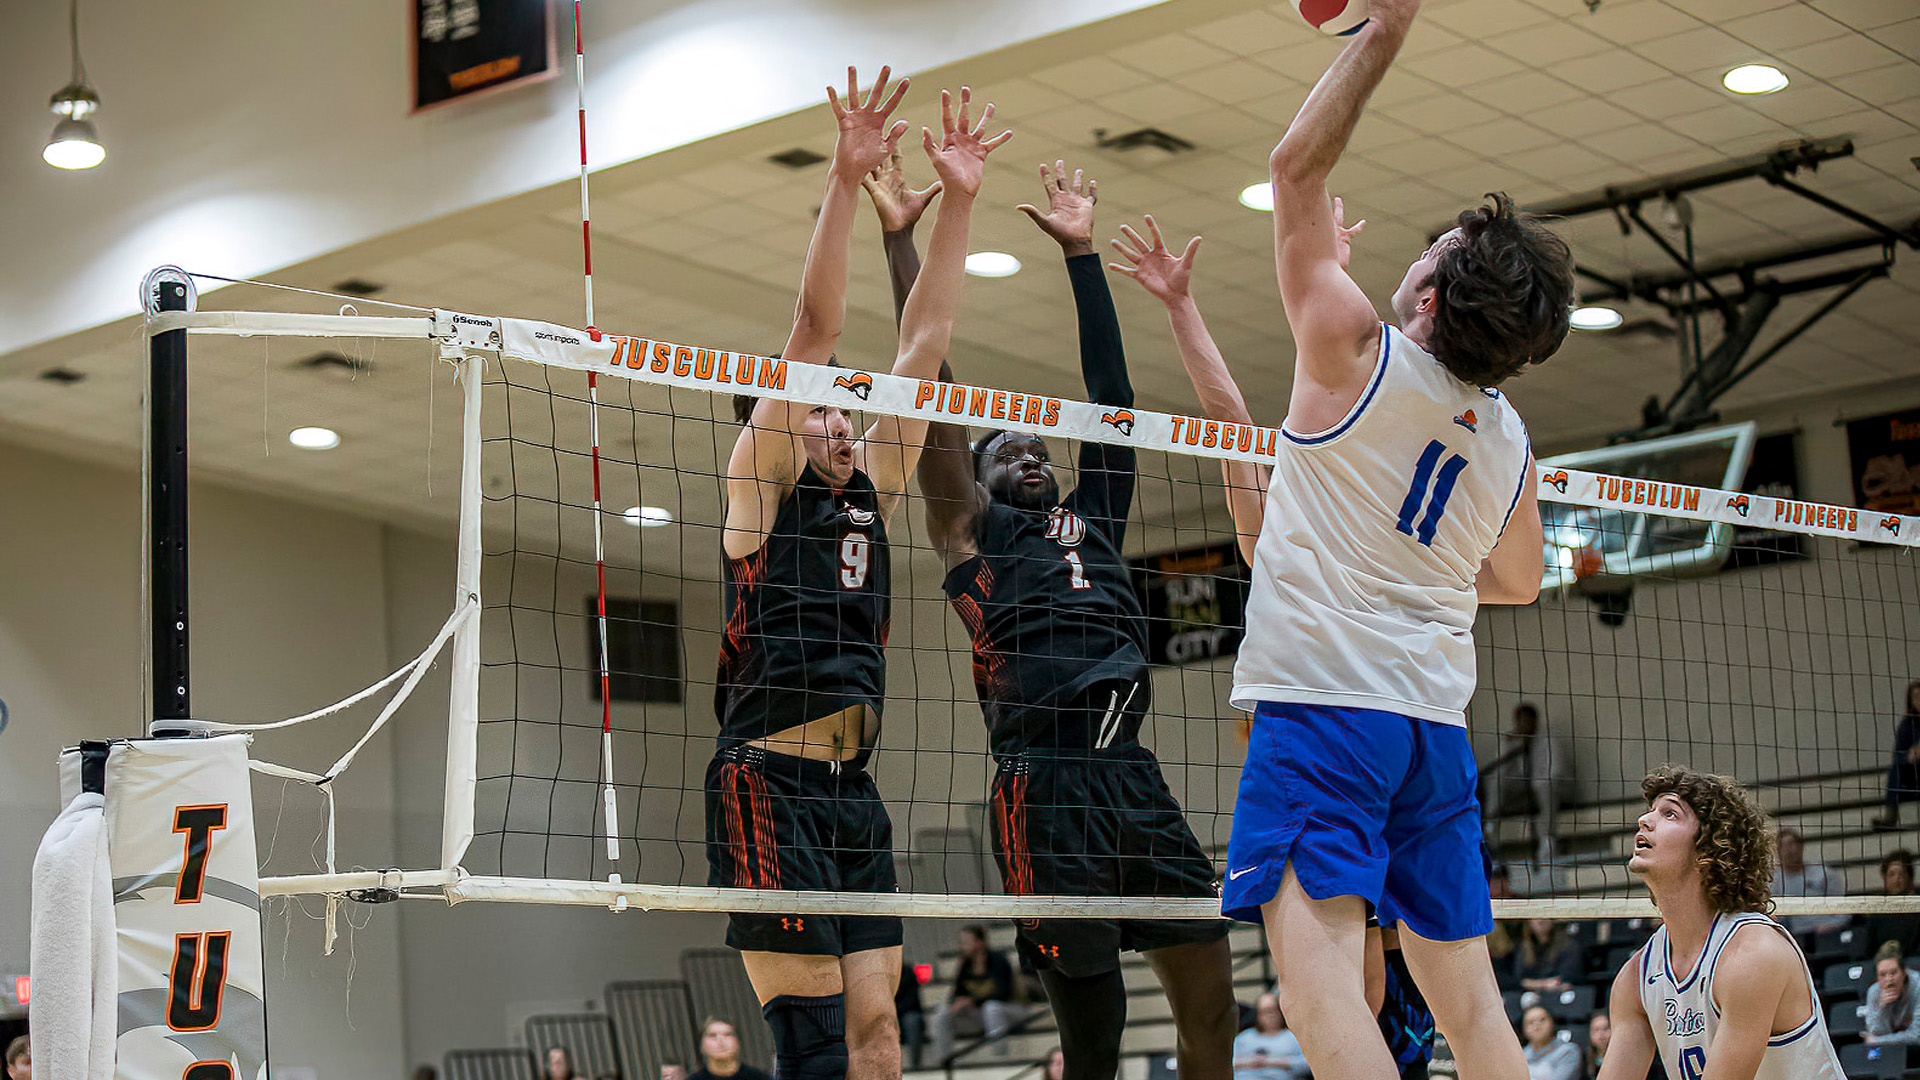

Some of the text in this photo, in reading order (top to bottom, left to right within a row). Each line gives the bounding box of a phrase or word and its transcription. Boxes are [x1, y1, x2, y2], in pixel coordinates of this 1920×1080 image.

[609, 336, 788, 390] TUSCULUM
[915, 380, 1061, 426] PIONEERS
[1395, 439, 1469, 547] 11
[1596, 475, 1701, 511] TUSCULUM
[1775, 499, 1858, 531] PIONEERS
[839, 532, 870, 589] 9
[1063, 550, 1093, 590] 1
[166, 803, 234, 1080] TU
